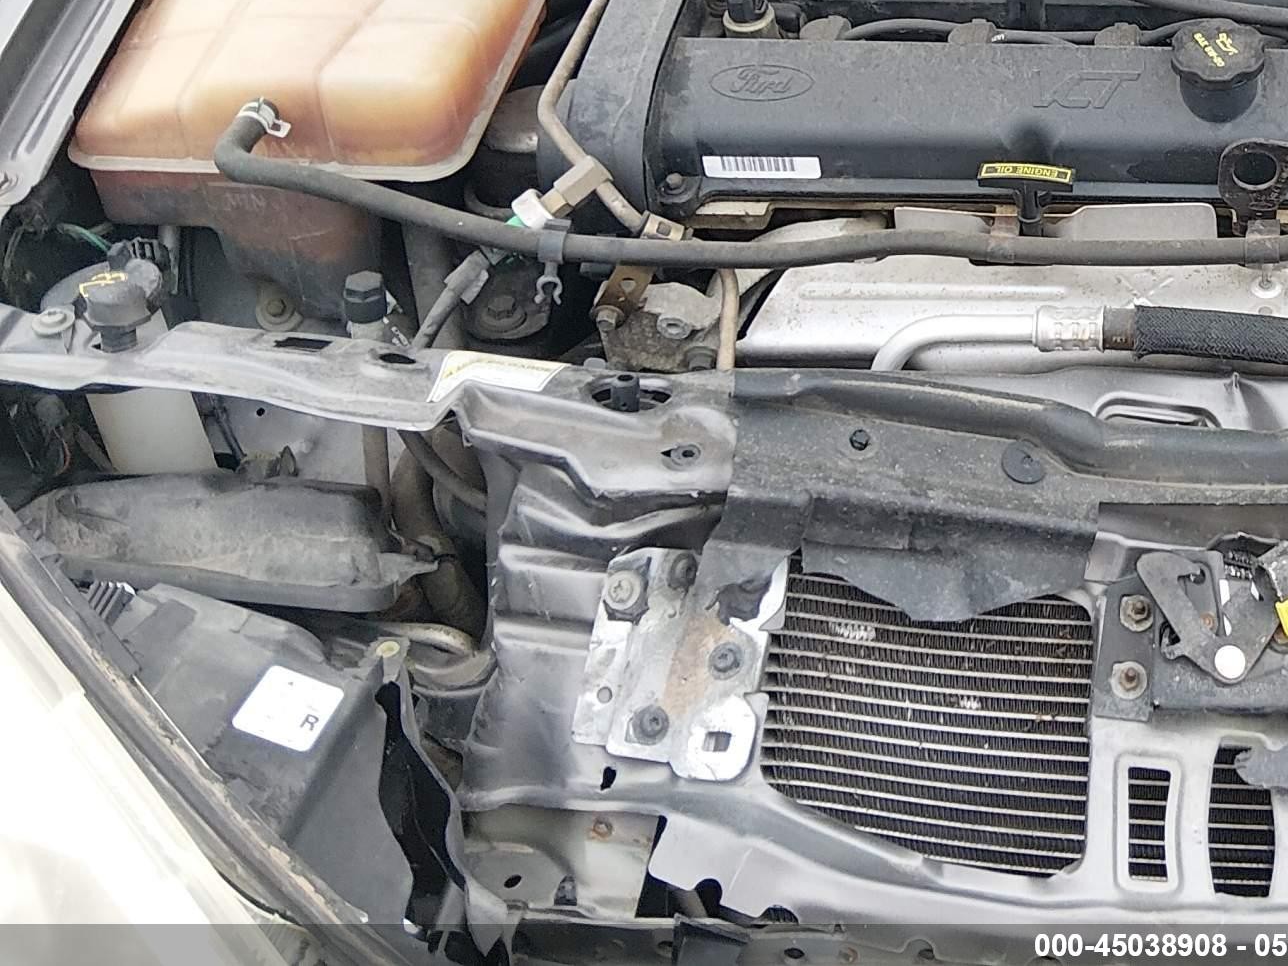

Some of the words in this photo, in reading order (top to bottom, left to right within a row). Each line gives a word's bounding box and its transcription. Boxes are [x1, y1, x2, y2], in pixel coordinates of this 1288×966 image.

[731, 68, 793, 94] Ford
[995, 165, 1013, 175] OIL
[1016, 166, 1058, 178] ENGINE
[300, 713, 320, 731] R
